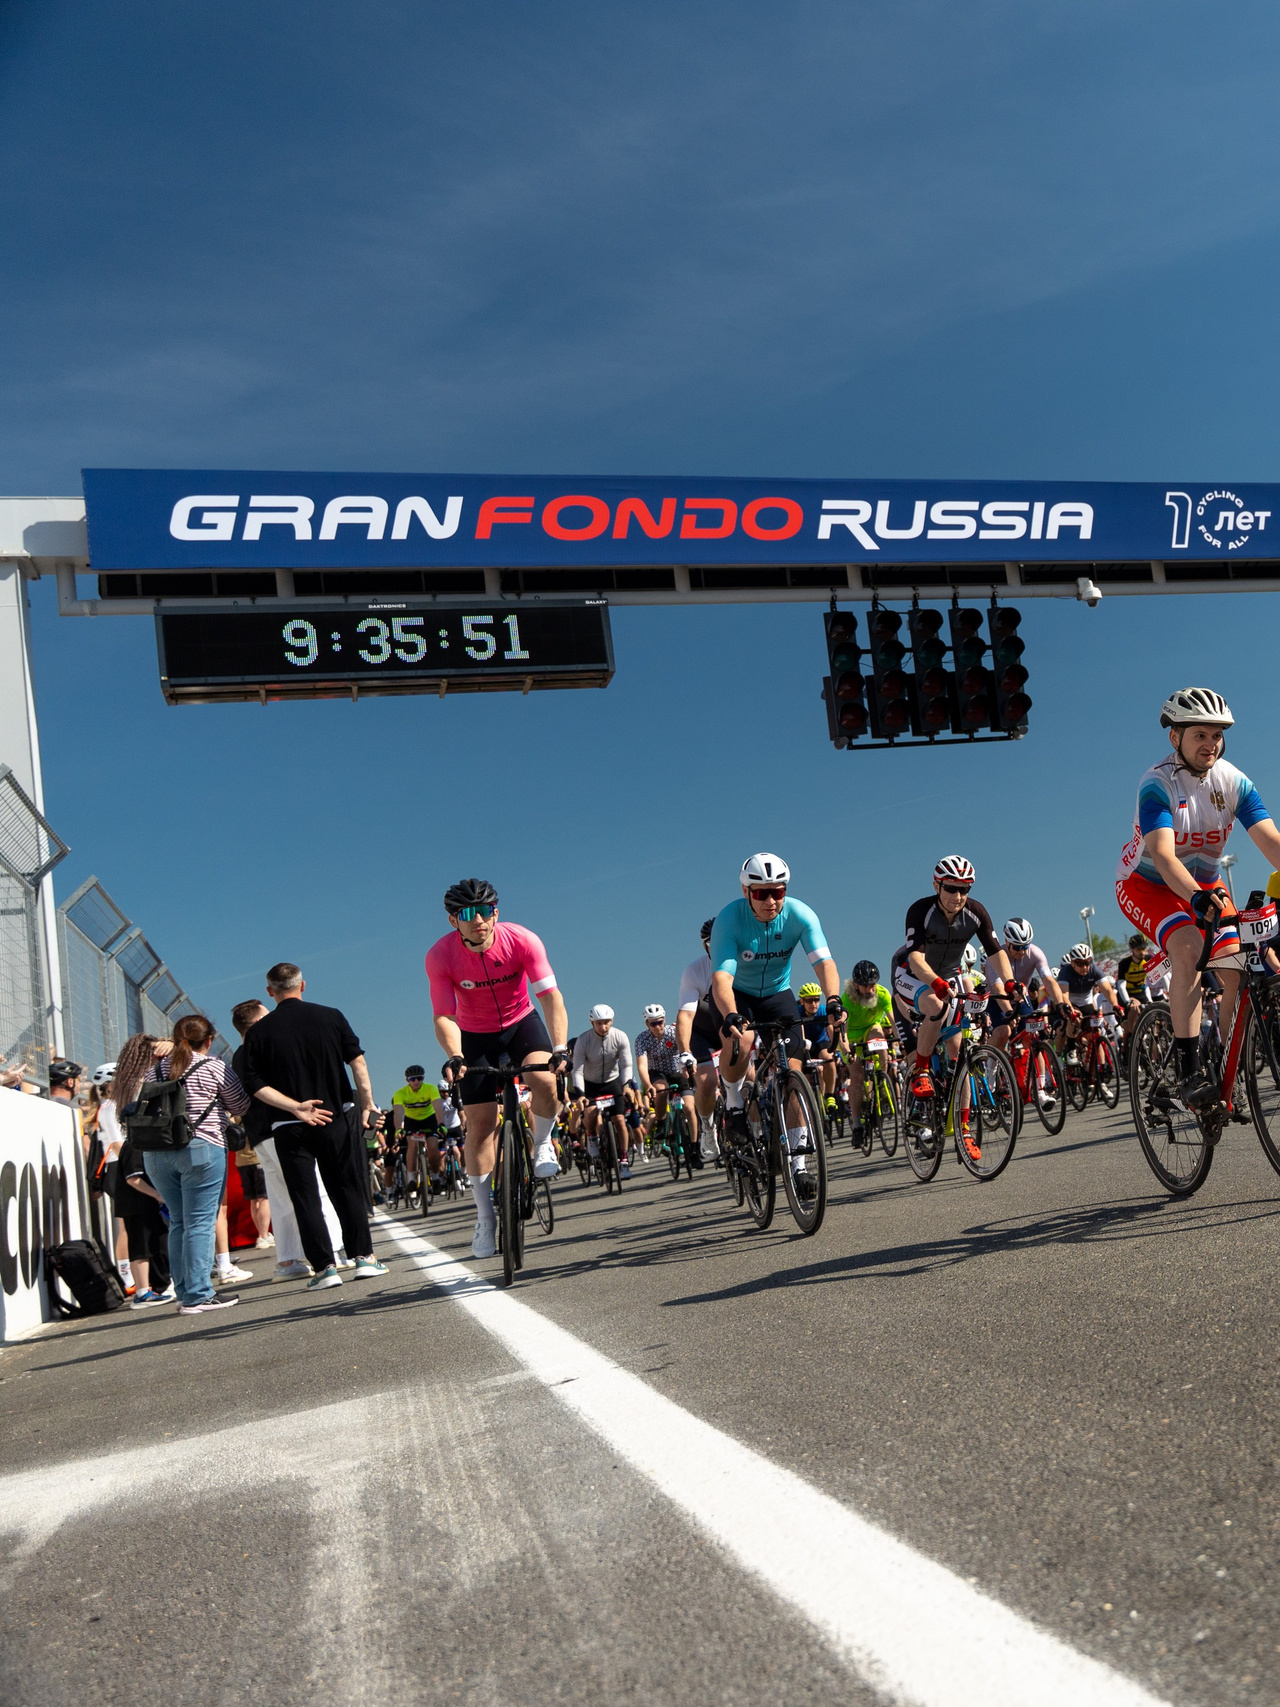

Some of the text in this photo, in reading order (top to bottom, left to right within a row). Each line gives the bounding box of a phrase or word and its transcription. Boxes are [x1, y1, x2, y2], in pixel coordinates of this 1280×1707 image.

[1197, 490, 1244, 516] CYCLING
[169, 495, 1094, 550] GRAN FONDO RUSSIA
[1214, 510, 1271, 531] лет
[1198, 524, 1249, 550] FOR ALL
[1116, 881, 1151, 933] RUSSIA
[1250, 918, 1273, 935] 1091
[896, 979, 914, 991] CUBE
